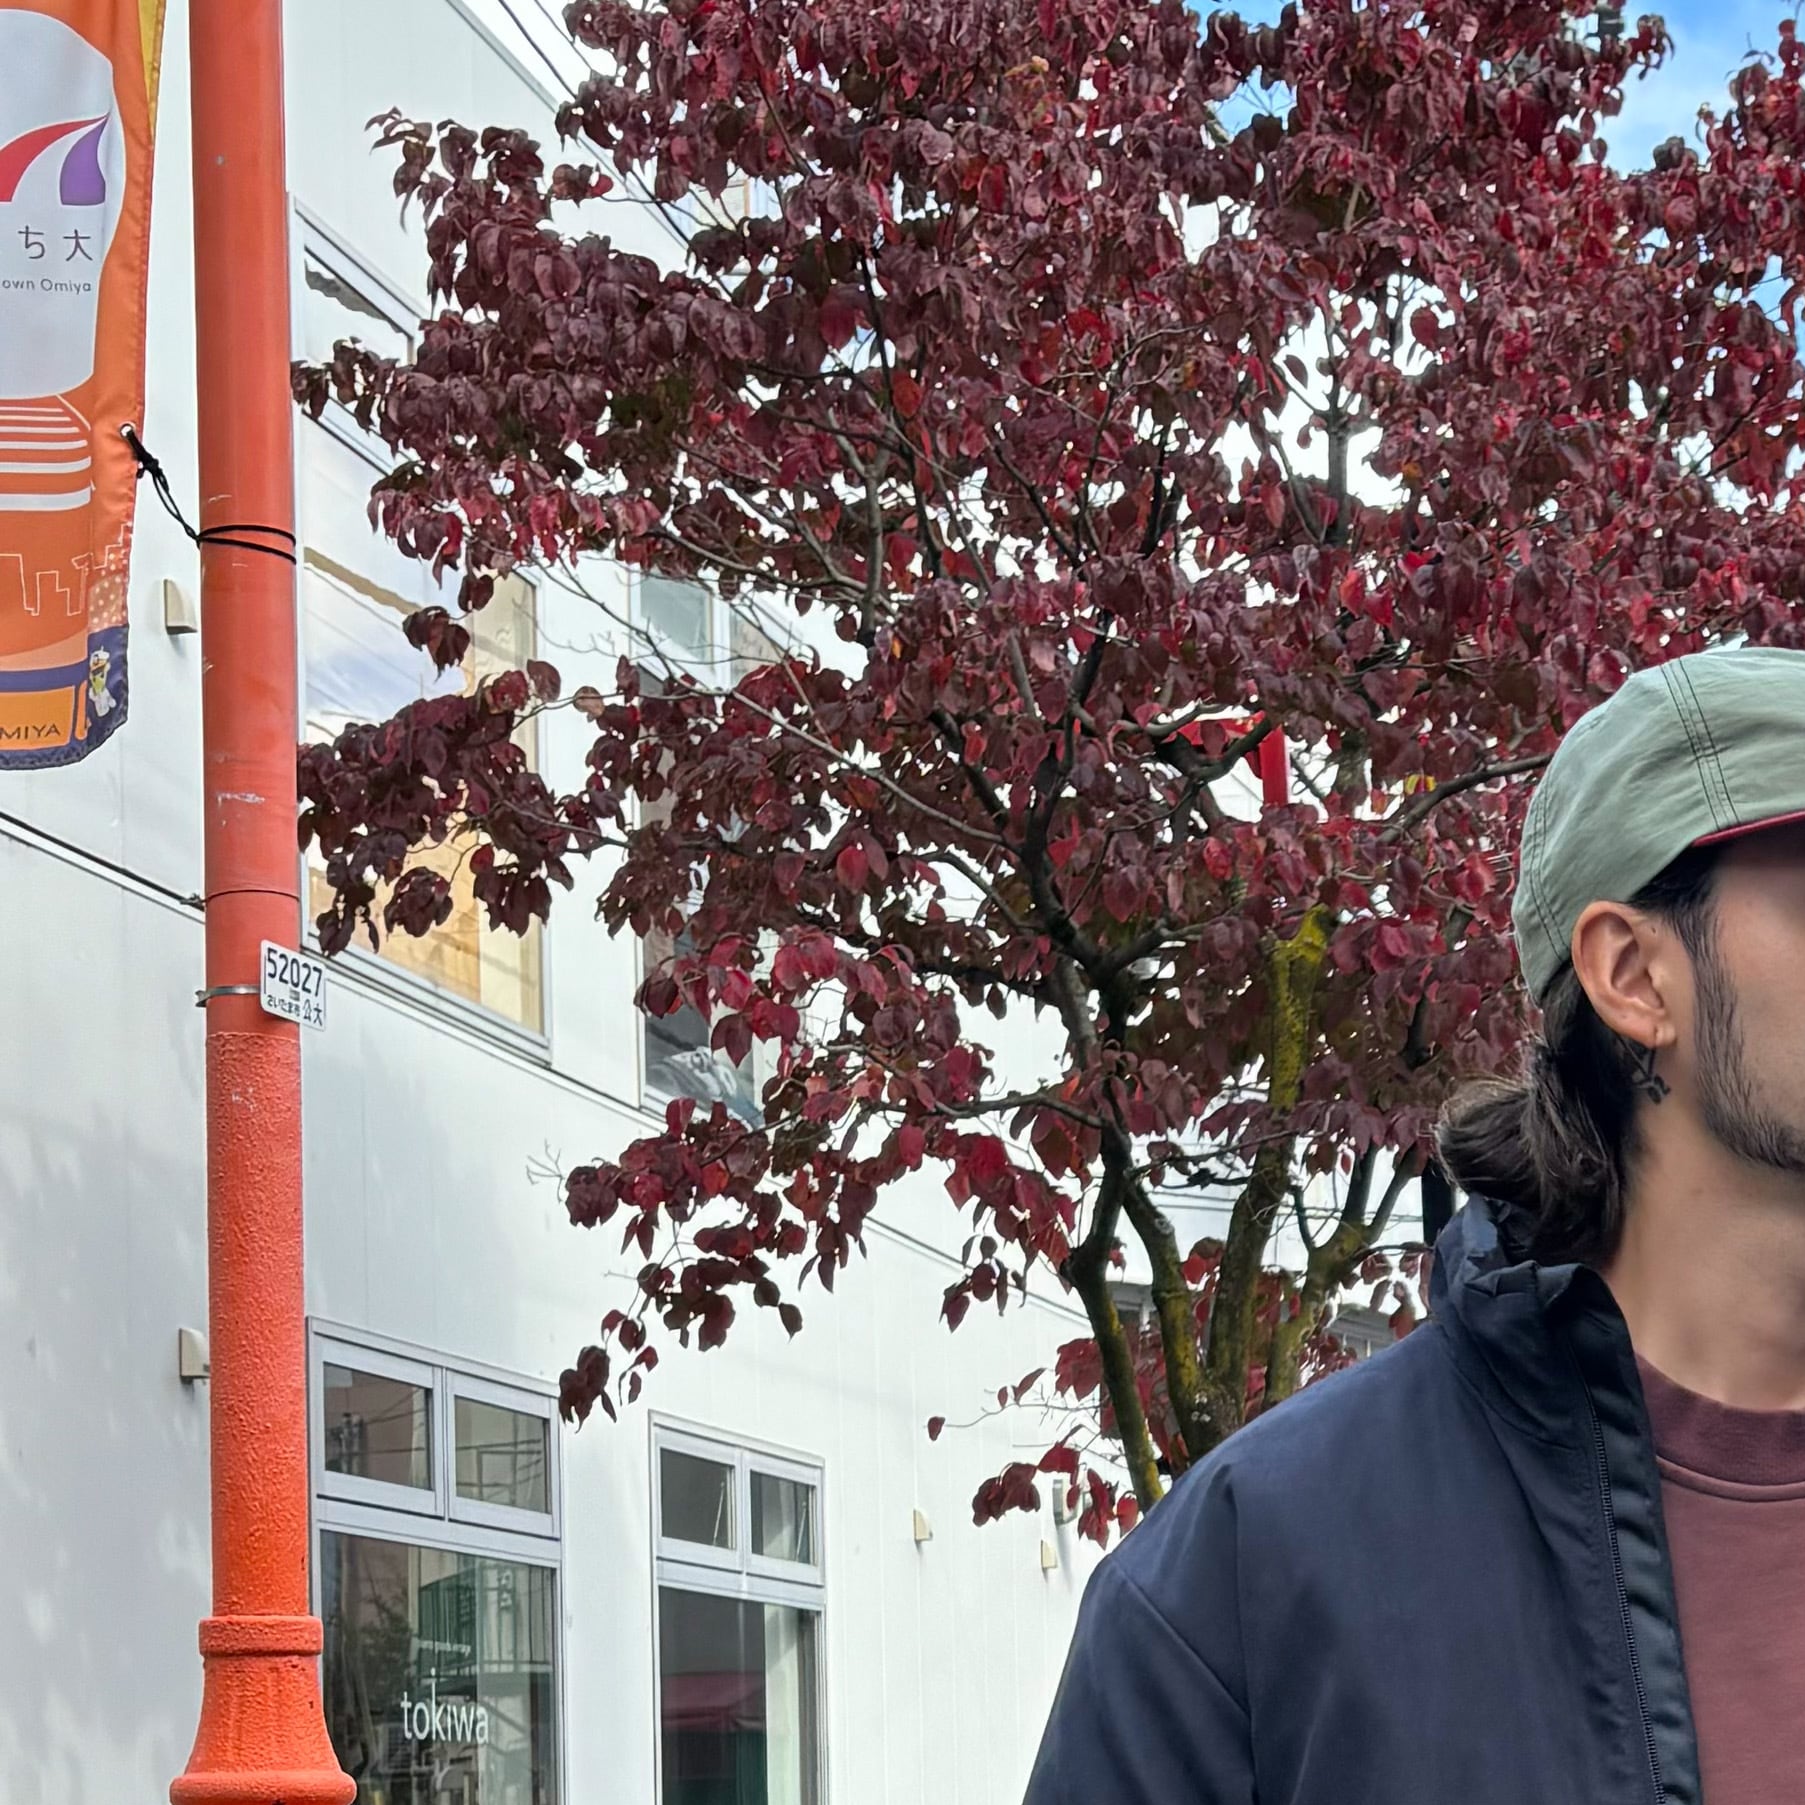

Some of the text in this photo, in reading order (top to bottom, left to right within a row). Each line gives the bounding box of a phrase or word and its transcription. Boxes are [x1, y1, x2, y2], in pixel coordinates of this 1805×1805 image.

[40, 278, 91, 296] Omiya
[267, 946, 323, 998] 52027
[400, 1674, 489, 1744] tokiwa
